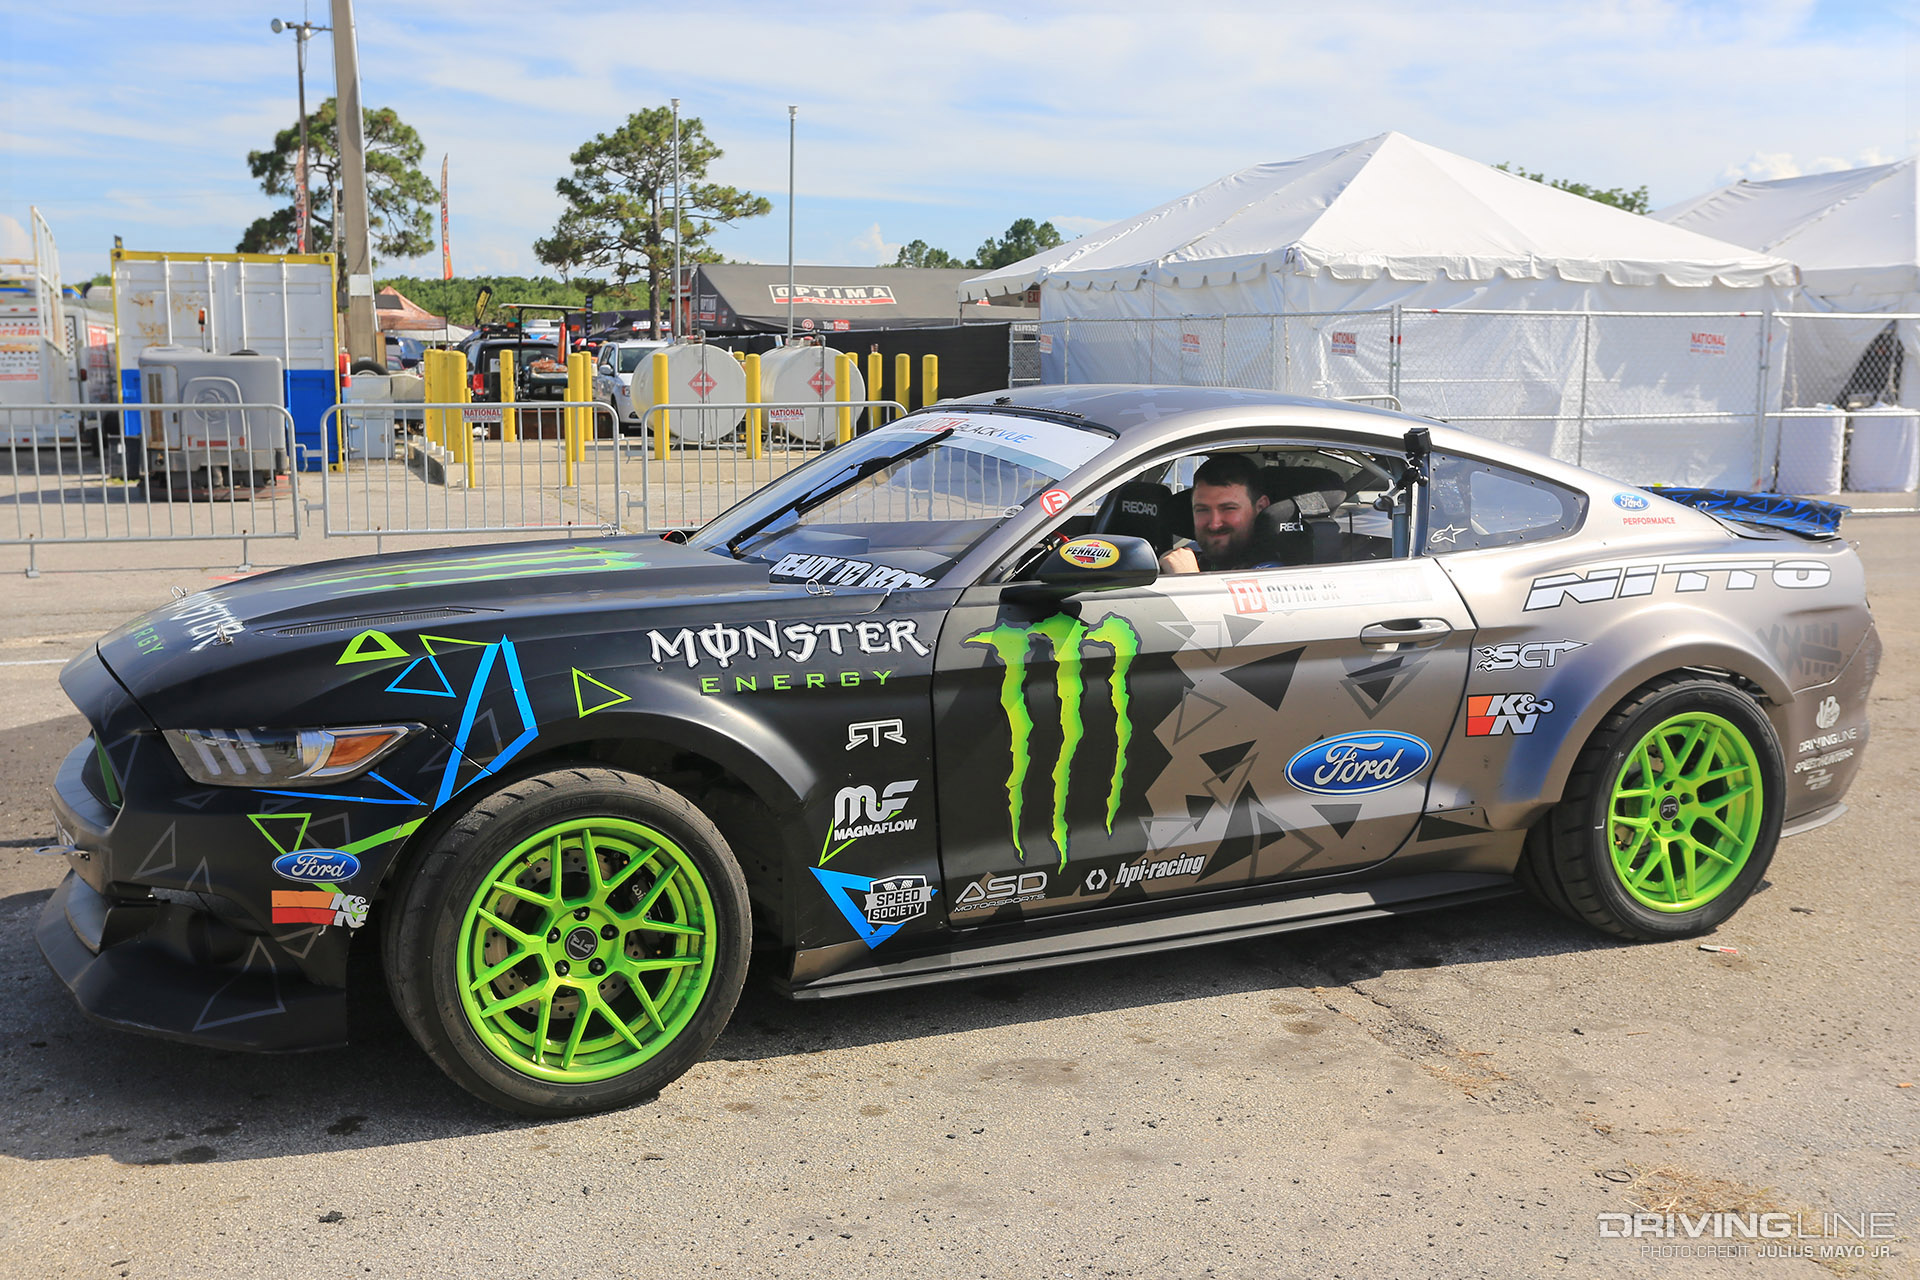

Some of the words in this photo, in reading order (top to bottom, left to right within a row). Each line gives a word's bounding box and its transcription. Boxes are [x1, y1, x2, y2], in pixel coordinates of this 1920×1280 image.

[776, 286, 888, 298] OPTIMA
[802, 297, 871, 305] BATTERIES
[823, 321, 849, 331] YouTube
[464, 408, 501, 417] NATIONAL
[770, 408, 804, 417] NATIONAL
[954, 422, 1033, 444] BLACKVUE
[1121, 500, 1158, 517] RECARO
[1623, 516, 1676, 526] PERFORMANCE
[1064, 546, 1112, 559] PENNZOIL
[769, 553, 843, 581] READY
[1522, 559, 1832, 612] NITTO
[646, 619, 930, 668] MONSTER
[1480, 639, 1590, 671] SCT
[701, 670, 892, 694] ENERGY
[845, 718, 907, 751] RTR
[1313, 741, 1404, 786] Ford
[833, 819, 917, 842] MAGNAFLOW
[291, 853, 347, 877] Ford
[876, 889, 921, 907] SPEED
[955, 871, 1048, 904] ASD
[872, 903, 923, 920] SOCIETY
[953, 893, 1046, 913] MOTORSPORTS
